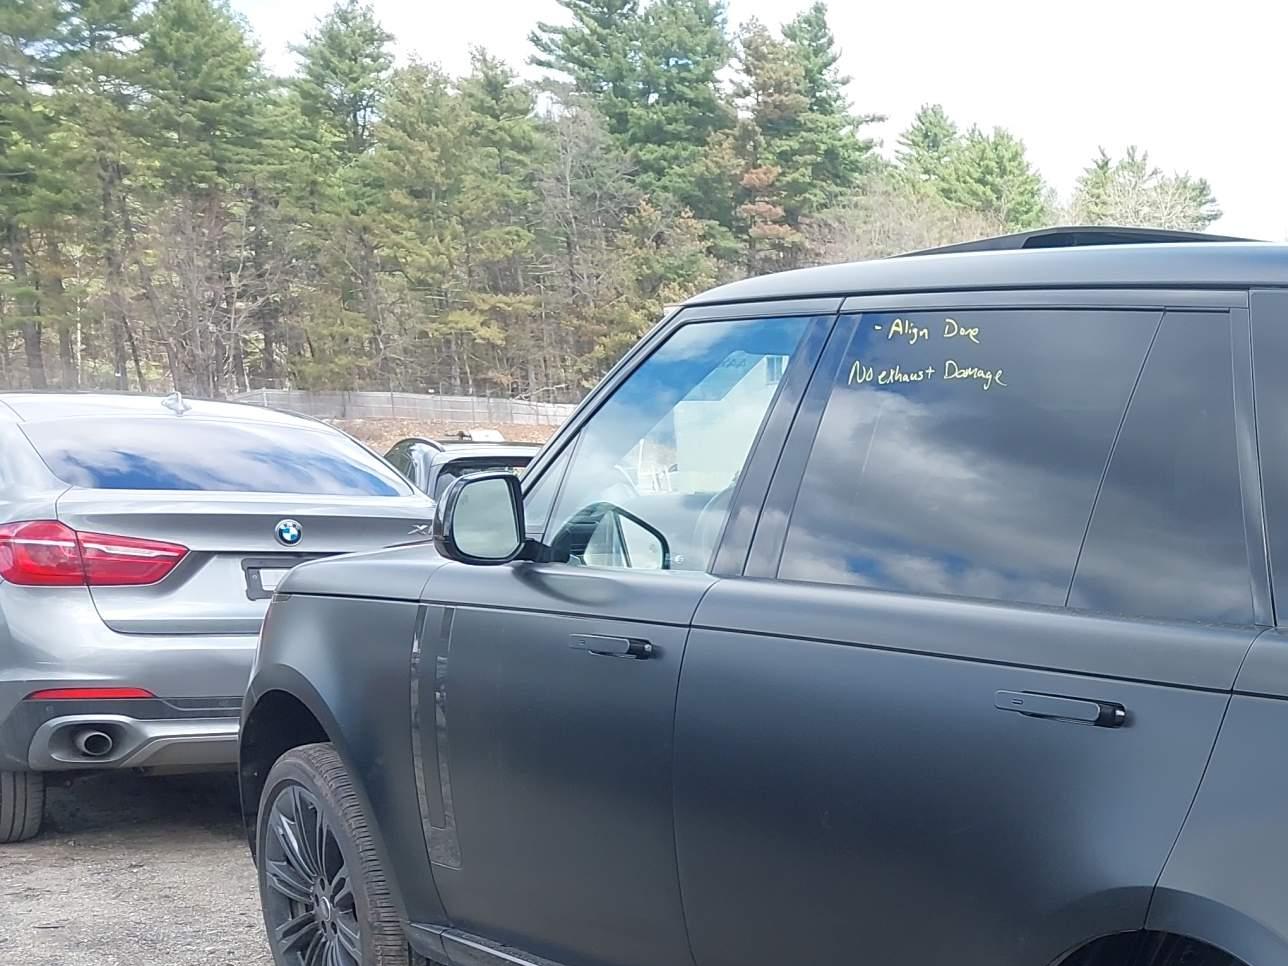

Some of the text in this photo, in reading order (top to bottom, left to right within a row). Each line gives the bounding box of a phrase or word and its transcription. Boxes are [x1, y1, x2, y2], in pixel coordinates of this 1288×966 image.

[888, 318, 929, 344] Align
[943, 318, 980, 344] Done
[878, 365, 936, 385] exhaust
[943, 360, 1007, 390] Damage
